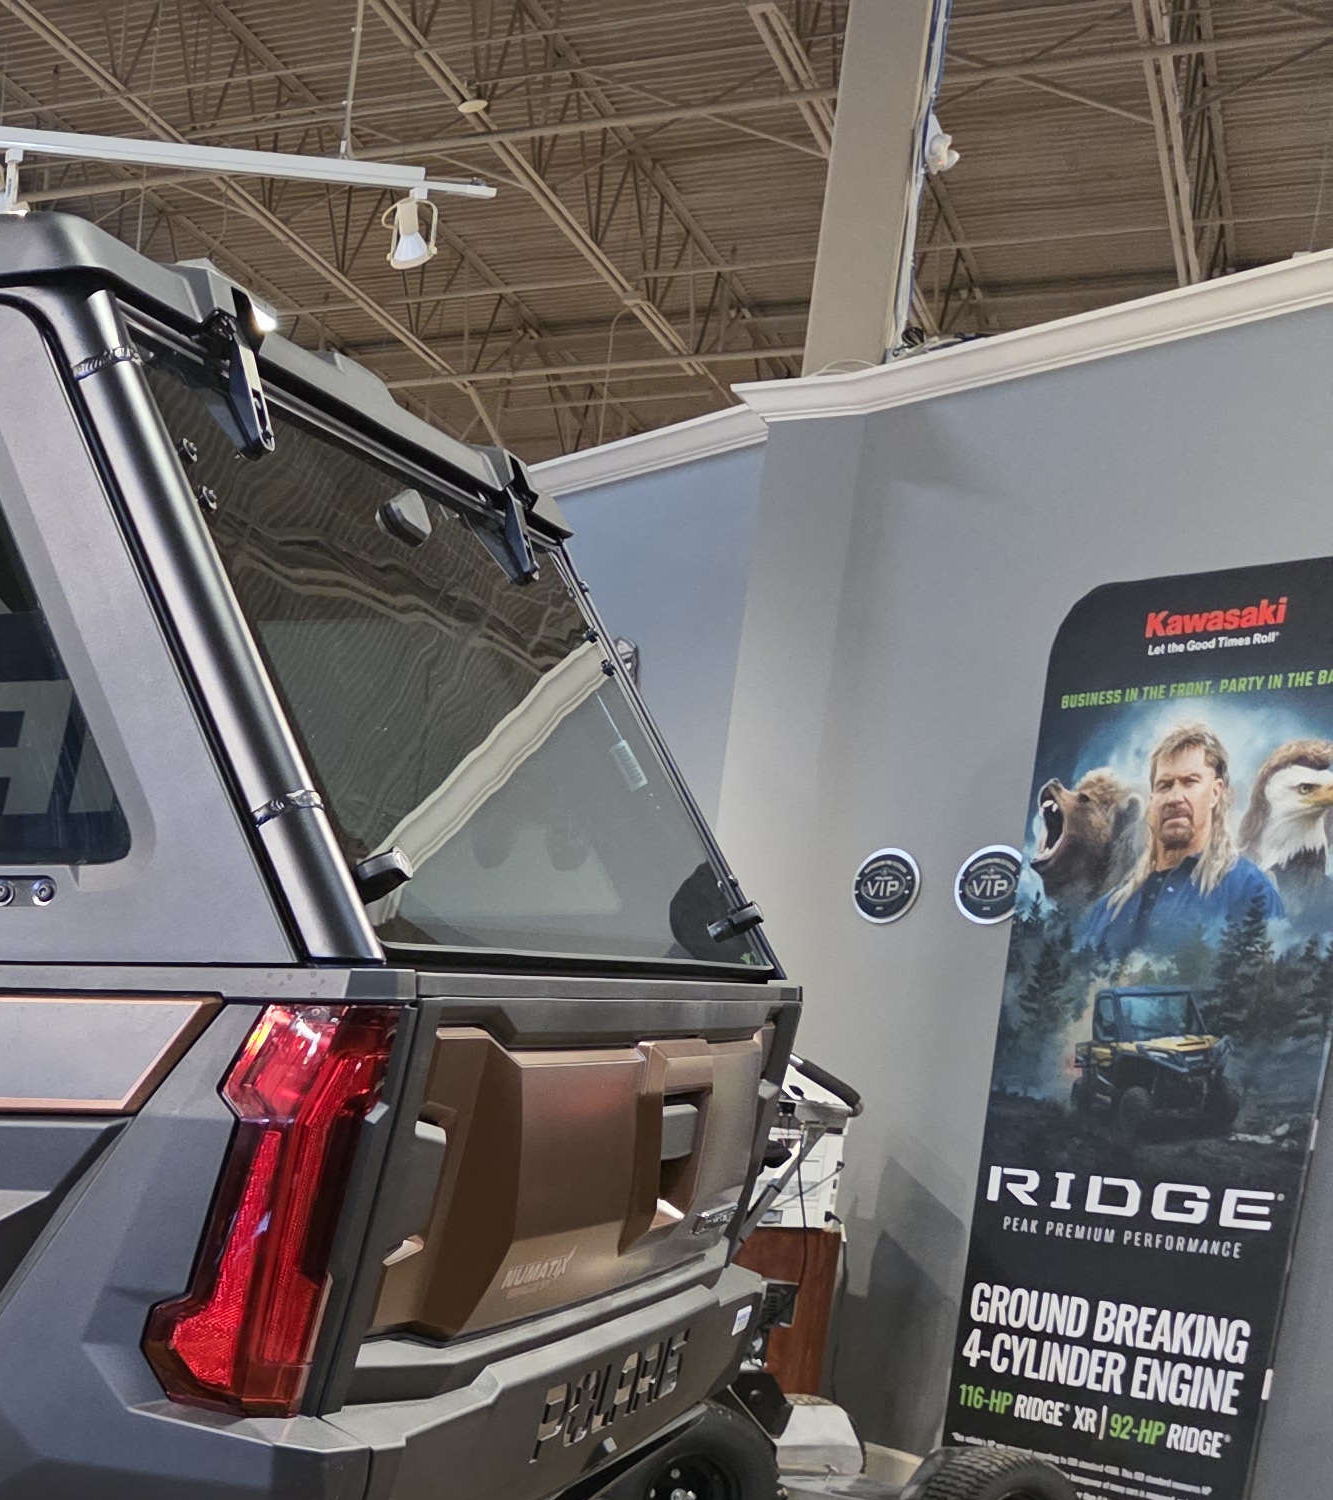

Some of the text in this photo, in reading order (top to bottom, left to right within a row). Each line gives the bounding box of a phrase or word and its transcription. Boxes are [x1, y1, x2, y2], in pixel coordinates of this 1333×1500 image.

[1145, 596, 1288, 638] Kawasaki
[1147, 644, 1166, 656] Let
[1167, 642, 1185, 653] the
[1186, 637, 1216, 652] Good
[1218, 635, 1251, 648] Times
[1061, 689, 1122, 709] BUSINESS
[1124, 687, 1139, 703] IN
[1142, 684, 1167, 700] THE
[1169, 680, 1215, 698] FRONT.
[1219, 675, 1265, 693] PARTY
[1267, 673, 1283, 689] IN
[1287, 671, 1314, 688] THE
[867, 880, 900, 897] VIP
[972, 879, 1008, 897] VIP
[986, 1165, 1277, 1232] RIDGE
[1003, 1216, 1243, 1260] PEAK PREMIUM PERFORMANCE
[969, 1282, 1252, 1365] GROUND BREAKING
[962, 1328, 1245, 1416] 4-CYLINDER ENGINE
[529, 1328, 690, 1464] POLARIS
[959, 1384, 1014, 1415] 116-HP
[1072, 1407, 1097, 1433] XR
[1109, 1413, 1166, 1446] 92-HP
